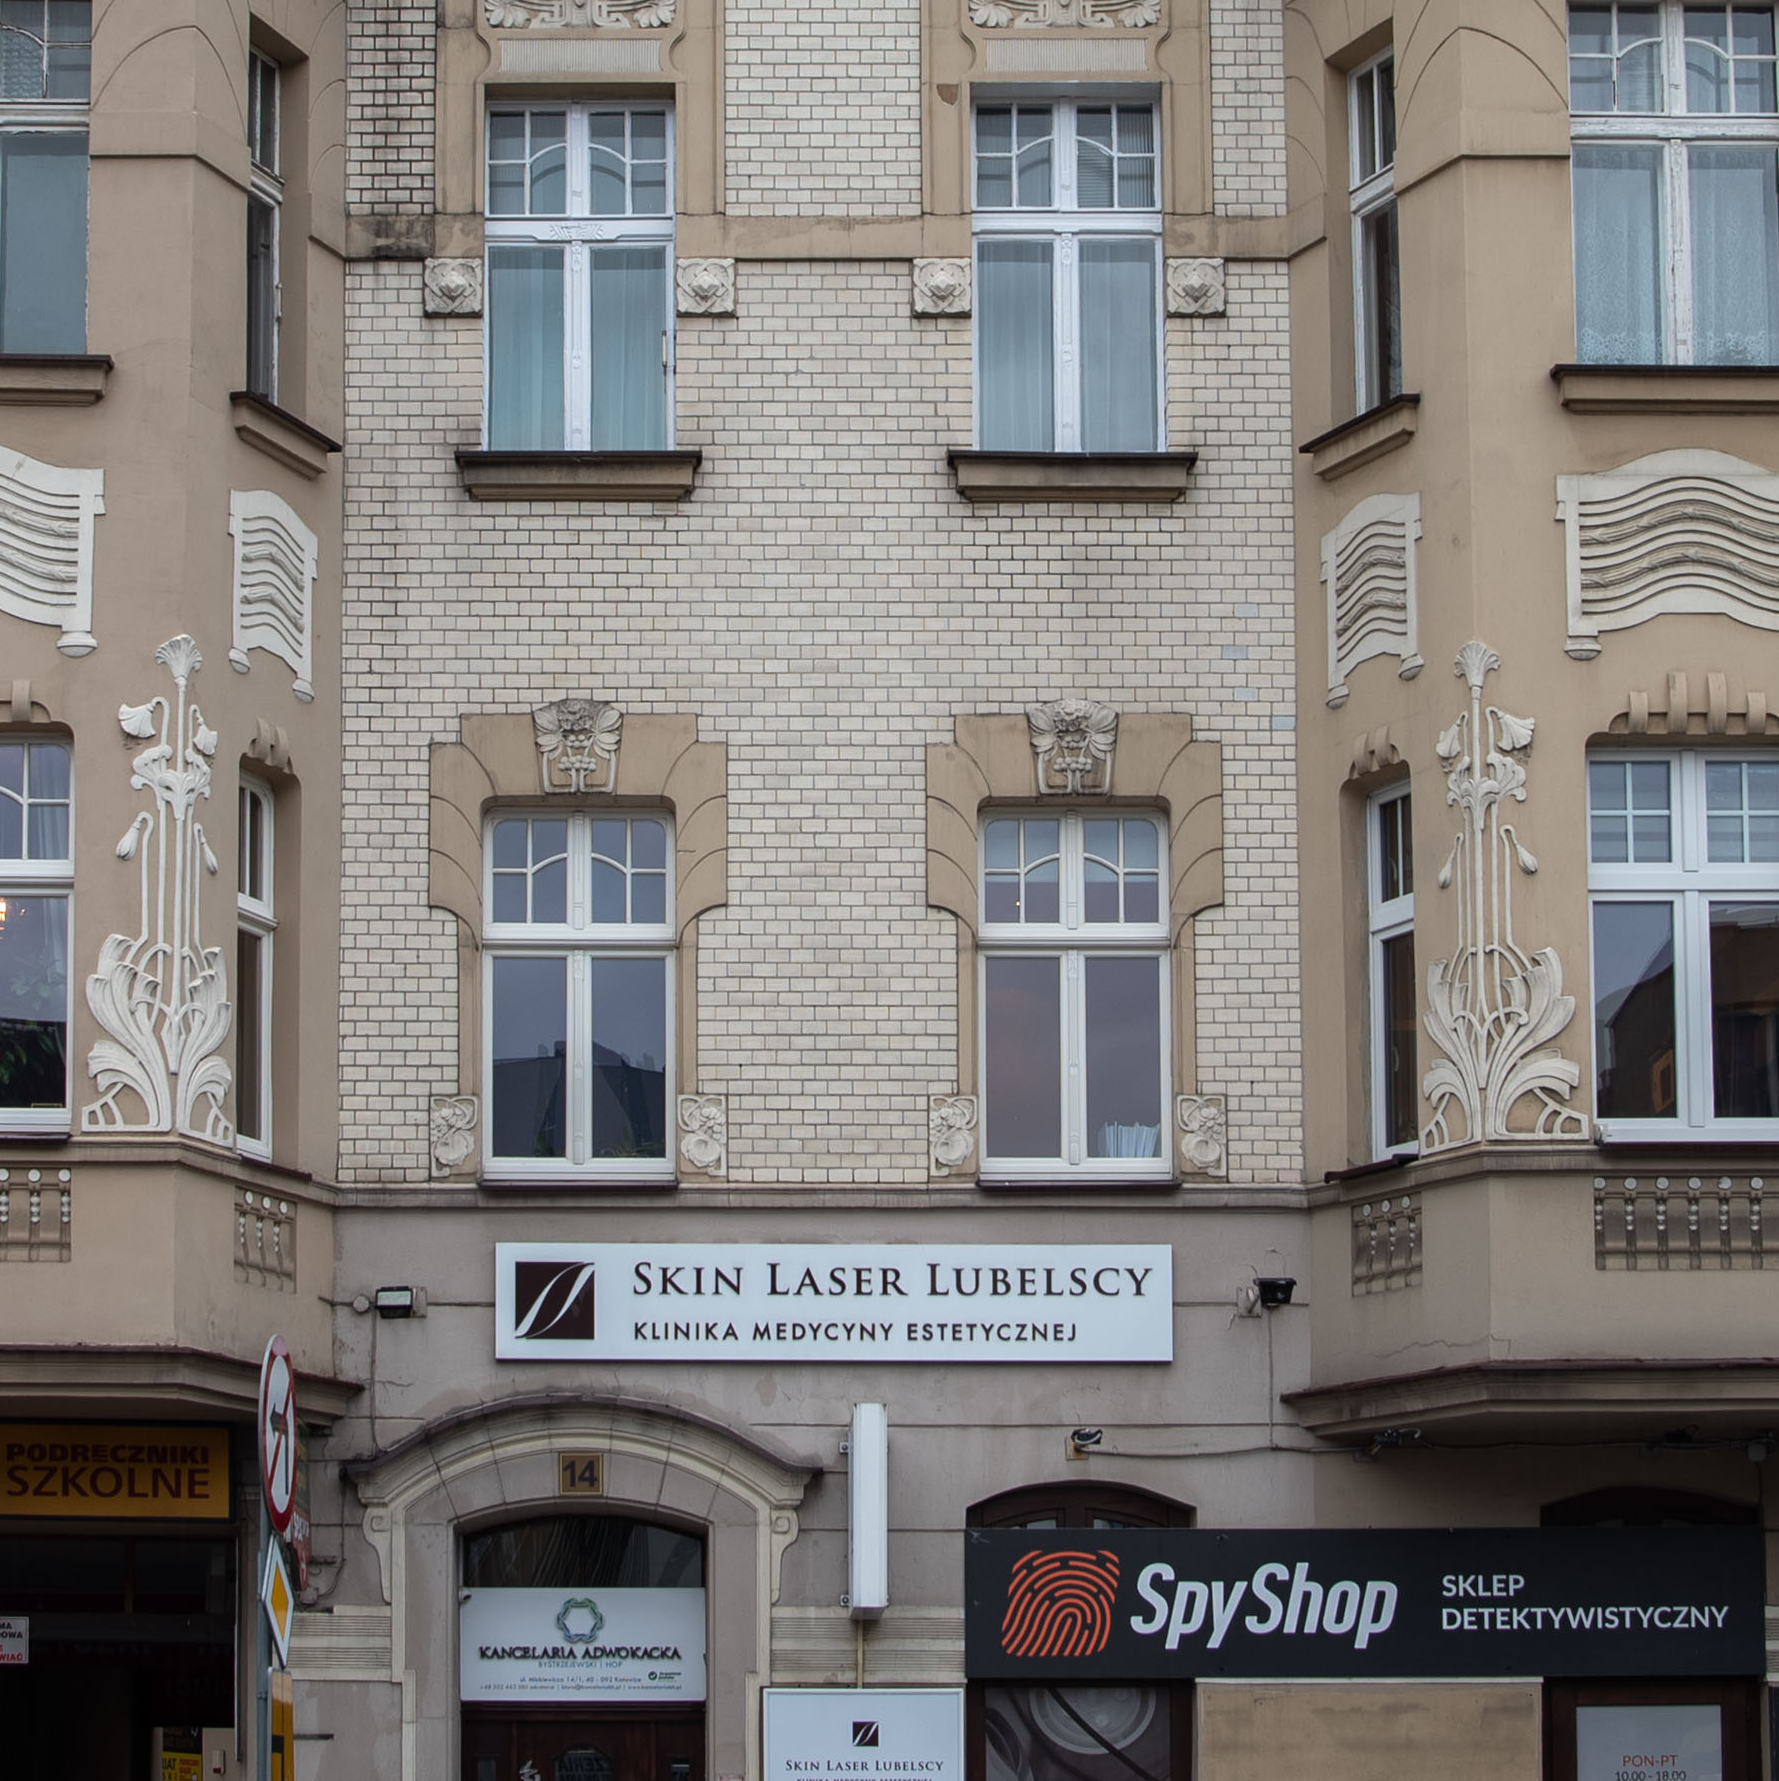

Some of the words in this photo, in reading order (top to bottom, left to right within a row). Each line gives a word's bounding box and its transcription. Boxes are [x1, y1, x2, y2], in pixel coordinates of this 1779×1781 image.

[632, 1261, 743, 1297] SKIN
[767, 1262, 908, 1298] LASER
[927, 1262, 1154, 1299] LUBELSCY
[633, 1321, 739, 1342] KLINIKA
[752, 1321, 896, 1342] MEDYCYNY
[907, 1322, 1077, 1344] ESTETYCZNEJ
[6, 1443, 210, 1465] PODRĘCZNIKI
[7, 1466, 210, 1499] SZKOLNE
[563, 1459, 598, 1490] 14
[1441, 1574, 1525, 1597] SKLEP
[1130, 1561, 1398, 1650] SpyShop
[1441, 1605, 1729, 1630] DETEKTYWISTYCZNY
[479, 1646, 577, 1659] KANCELARIA
[582, 1645, 682, 1659] ADWOKACKA
[785, 1759, 820, 1771] SKIN
[827, 1760, 869, 1771] LASER
[875, 1760, 944, 1772] LUBELSCY
[1622, 1755, 1678, 1767] PON-PT
